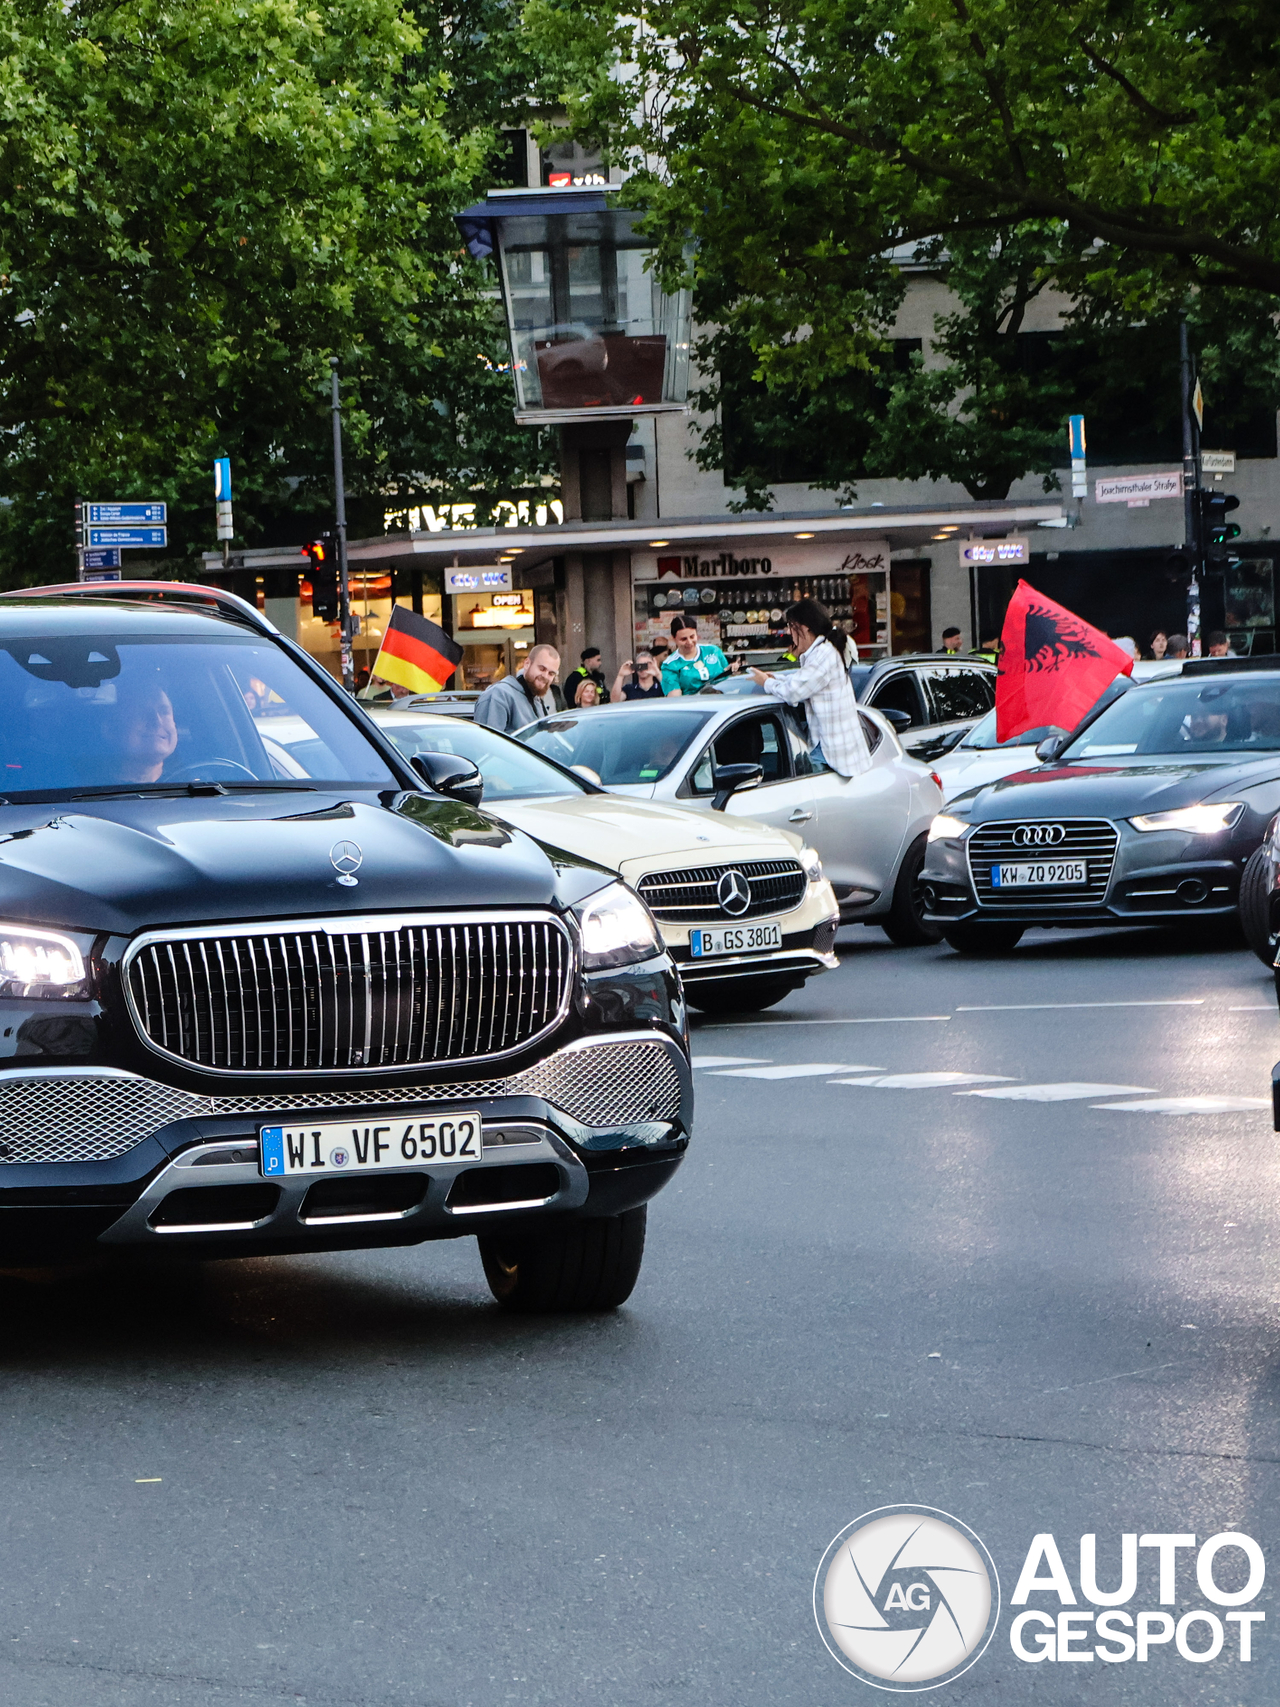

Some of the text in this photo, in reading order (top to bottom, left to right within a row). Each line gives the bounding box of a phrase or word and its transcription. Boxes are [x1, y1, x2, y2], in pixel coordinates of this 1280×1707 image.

[997, 543, 1024, 559] WC
[683, 552, 773, 578] Marlboro
[451, 571, 509, 589] City WC
[493, 595, 521, 606] OPEN
[1001, 864, 1083, 884] KW ZQ 9205
[703, 926, 780, 952] B GS 3801
[269, 1120, 476, 1169] D WI VF 6502
